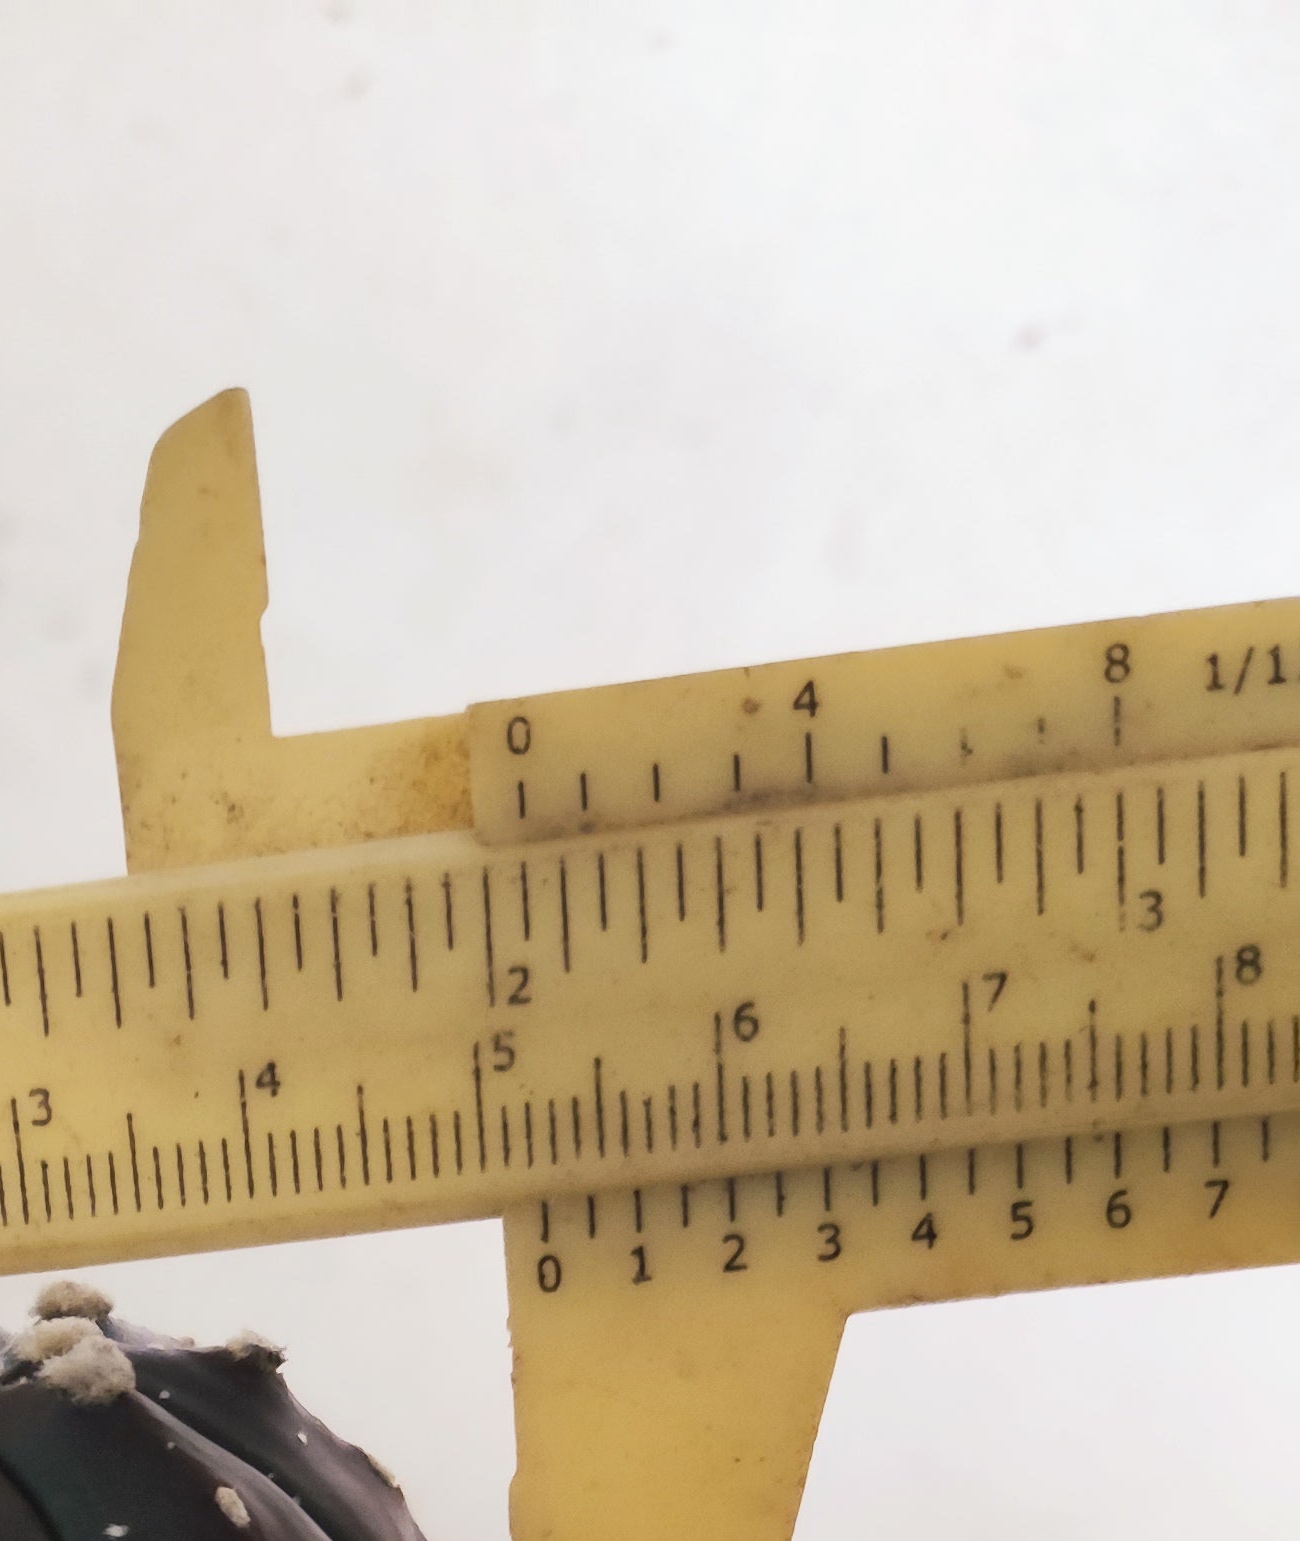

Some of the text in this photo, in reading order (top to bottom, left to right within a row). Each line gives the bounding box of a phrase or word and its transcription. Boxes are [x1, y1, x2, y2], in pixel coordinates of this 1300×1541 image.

[506, 642, 1300, 755] 0 4 8 1/1
[508, 965, 531, 1006] 2
[1139, 889, 1164, 933] 3
[29, 1088, 52, 1127] 3
[255, 1060, 281, 1097] 4
[491, 1030, 516, 1072] 5
[732, 1001, 759, 1042] 6
[982, 970, 1009, 1011] 7
[1235, 944, 1263, 985] 8
[537, 1178, 1232, 1293] 0 1 2 3 4 5 6 7
